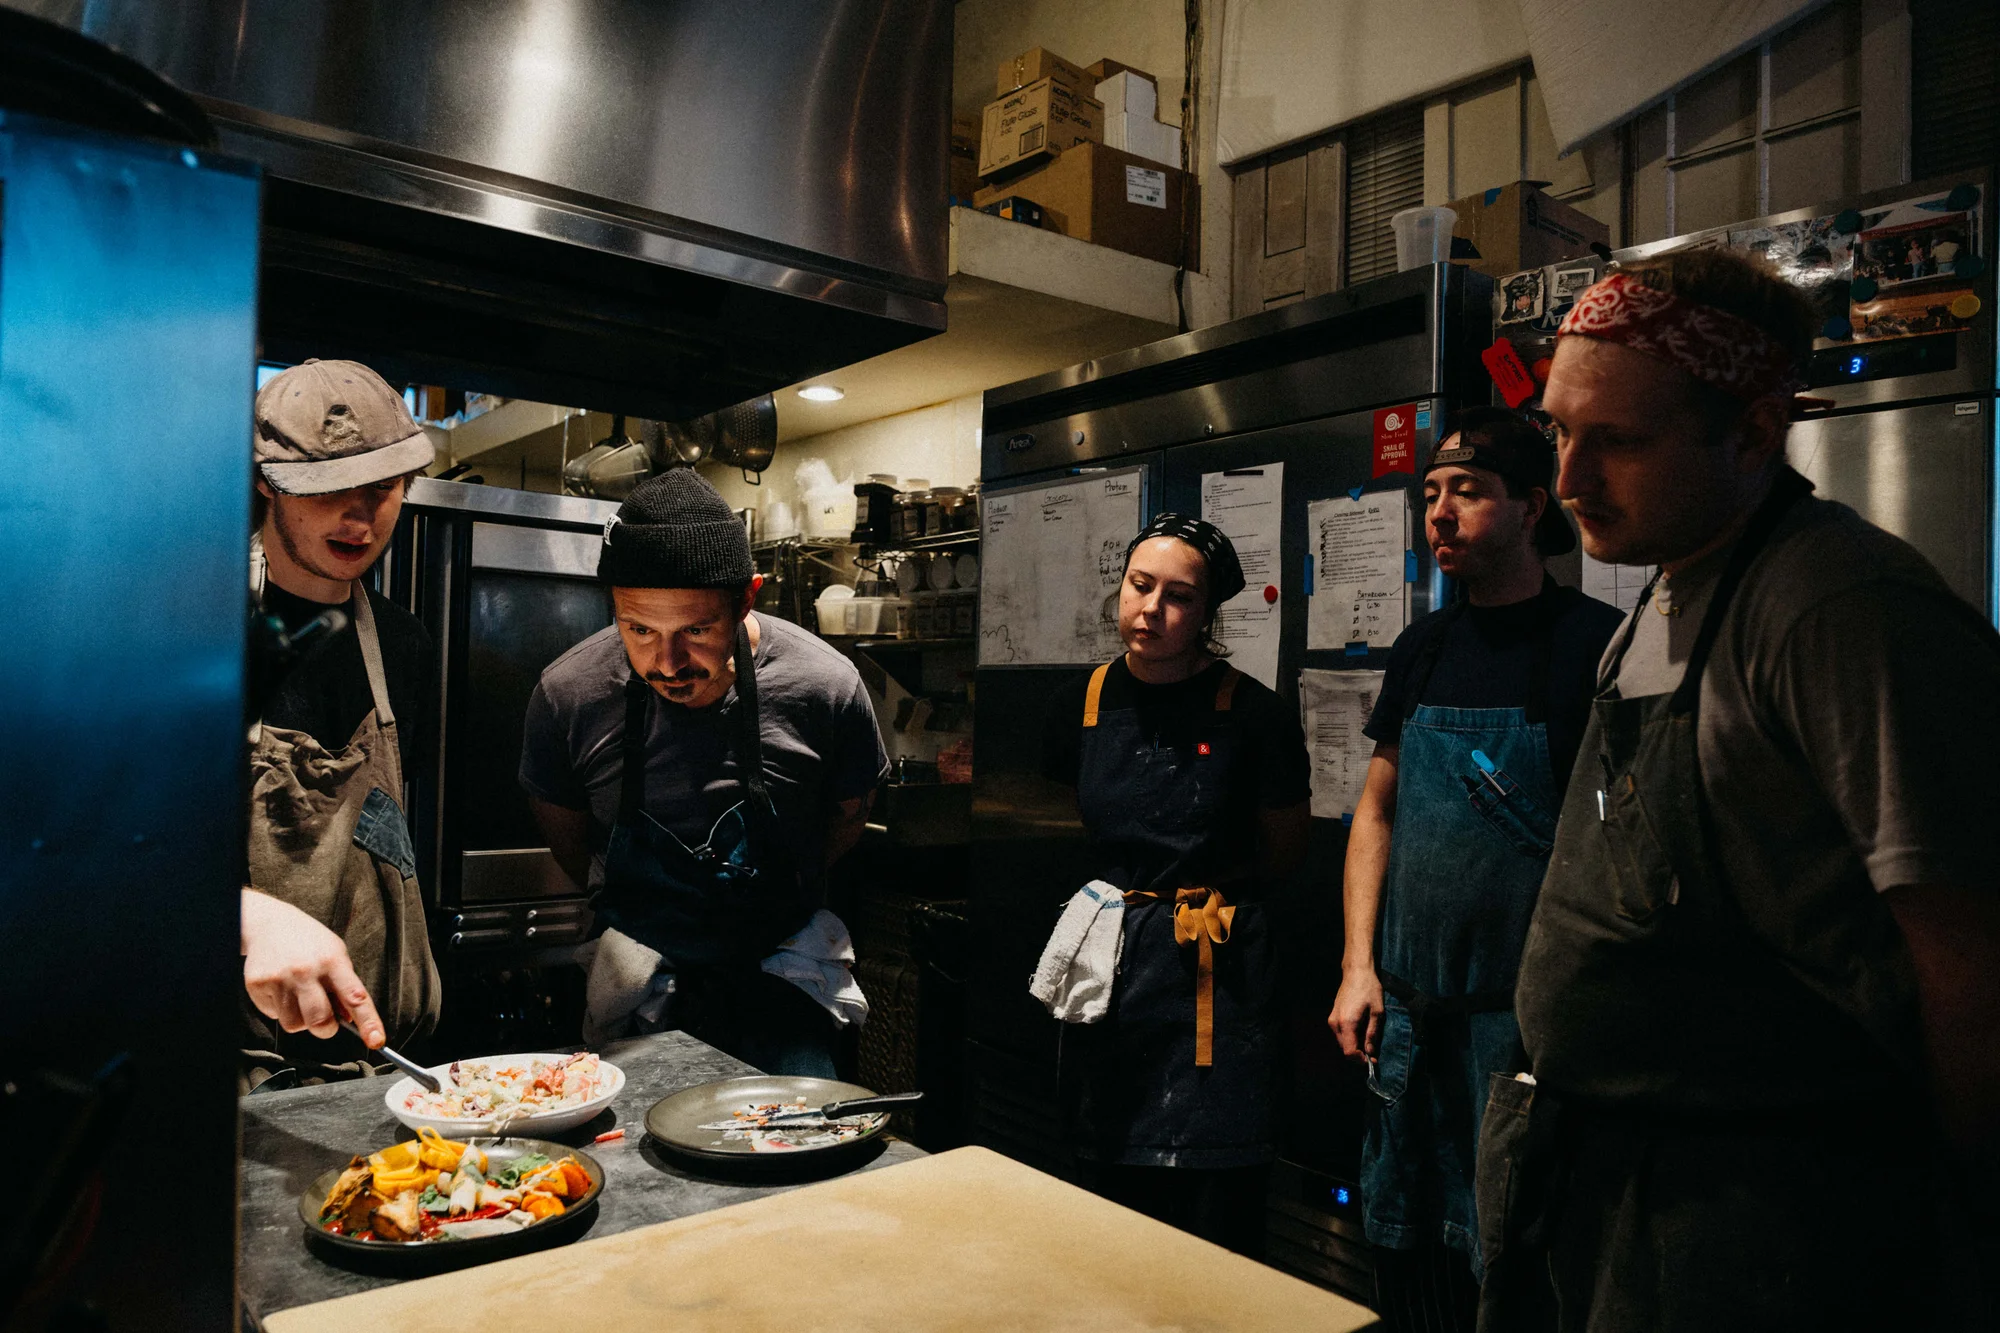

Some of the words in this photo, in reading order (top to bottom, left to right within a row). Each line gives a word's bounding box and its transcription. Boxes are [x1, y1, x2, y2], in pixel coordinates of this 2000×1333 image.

[1001, 116, 1017, 129] Flute
[1018, 107, 1038, 121] Glass
[1051, 102, 1070, 118] Flute
[1070, 111, 1092, 129] Glass
[1850, 357, 1861, 374] 3
[1381, 433, 1393, 441] Slow
[1383, 444, 1398, 453] SNAIL
[1398, 442, 1406, 451] OF
[1381, 450, 1408, 461] APPROVAL
